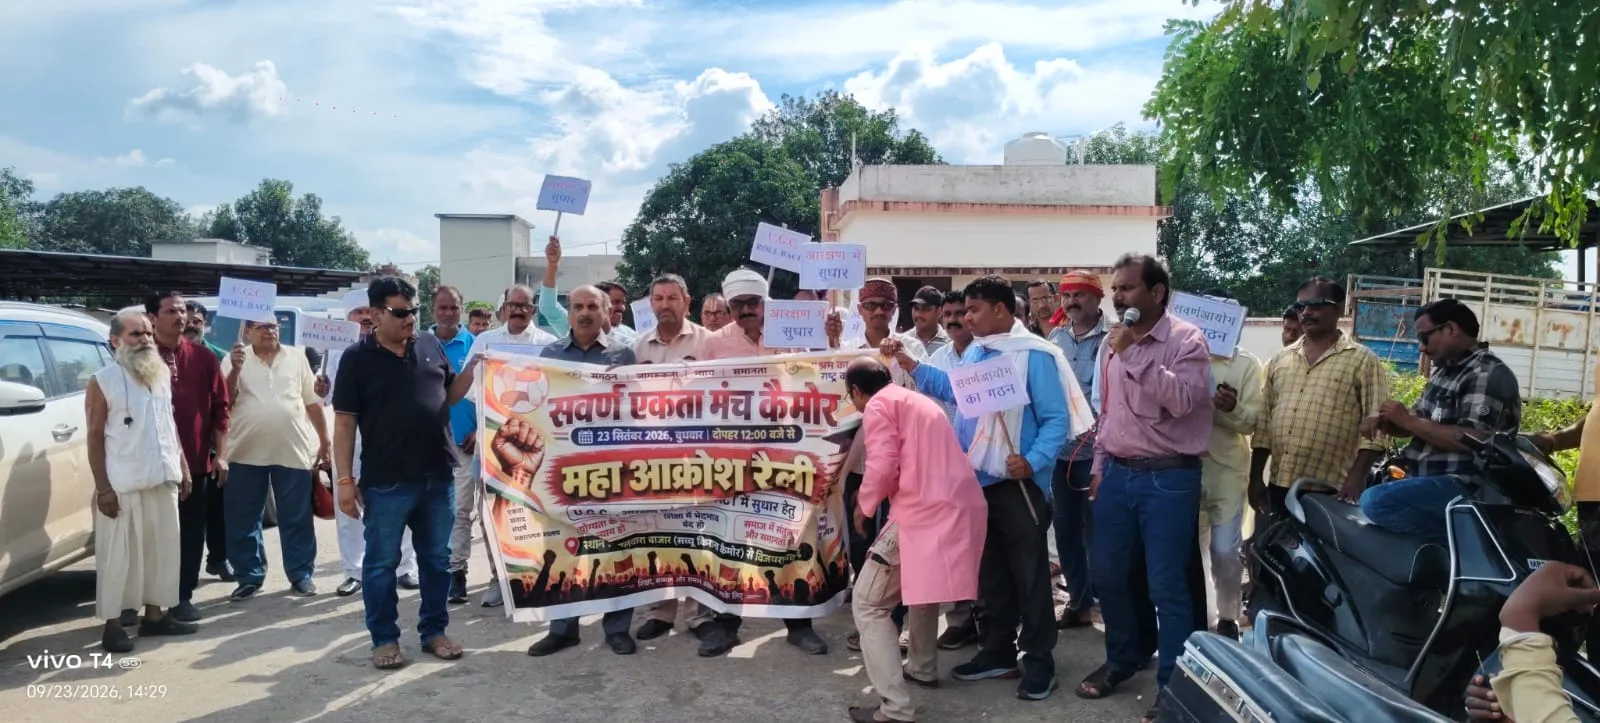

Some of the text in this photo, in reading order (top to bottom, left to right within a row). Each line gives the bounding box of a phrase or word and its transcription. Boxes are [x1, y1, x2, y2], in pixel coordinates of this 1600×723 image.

[756, 243, 780, 256] ROLL
[805, 250, 846, 261] आरक्षण
[818, 268, 849, 281] सुधार
[221, 298, 272, 312] ROLL BACK
[769, 309, 811, 320] आरक्षण
[302, 332, 327, 341] ROLL
[782, 326, 814, 340] सुधार
[732, 367, 767, 376] समानता
[820, 372, 838, 383] राष्ट्र
[964, 384, 1016, 405] का गठन
[547, 378, 841, 428] सवर्ण एकता मंच कैमोर
[597, 431, 610, 441] 23
[612, 428, 642, 441] सितंबर
[645, 430, 673, 442] 2026,
[712, 428, 738, 440] दोपहर
[741, 429, 767, 440] 12:00
[786, 427, 796, 439] से
[561, 449, 817, 498] महा आक्रोश रैली
[752, 498, 779, 514] सुधार
[781, 500, 797, 520] हेतु
[744, 520, 767, 531] समाज
[768, 520, 776, 532] में
[745, 530, 759, 540] और
[760, 533, 786, 546] समानता
[583, 539, 605, 549] स्थान
[746, 547, 755, 560] से
